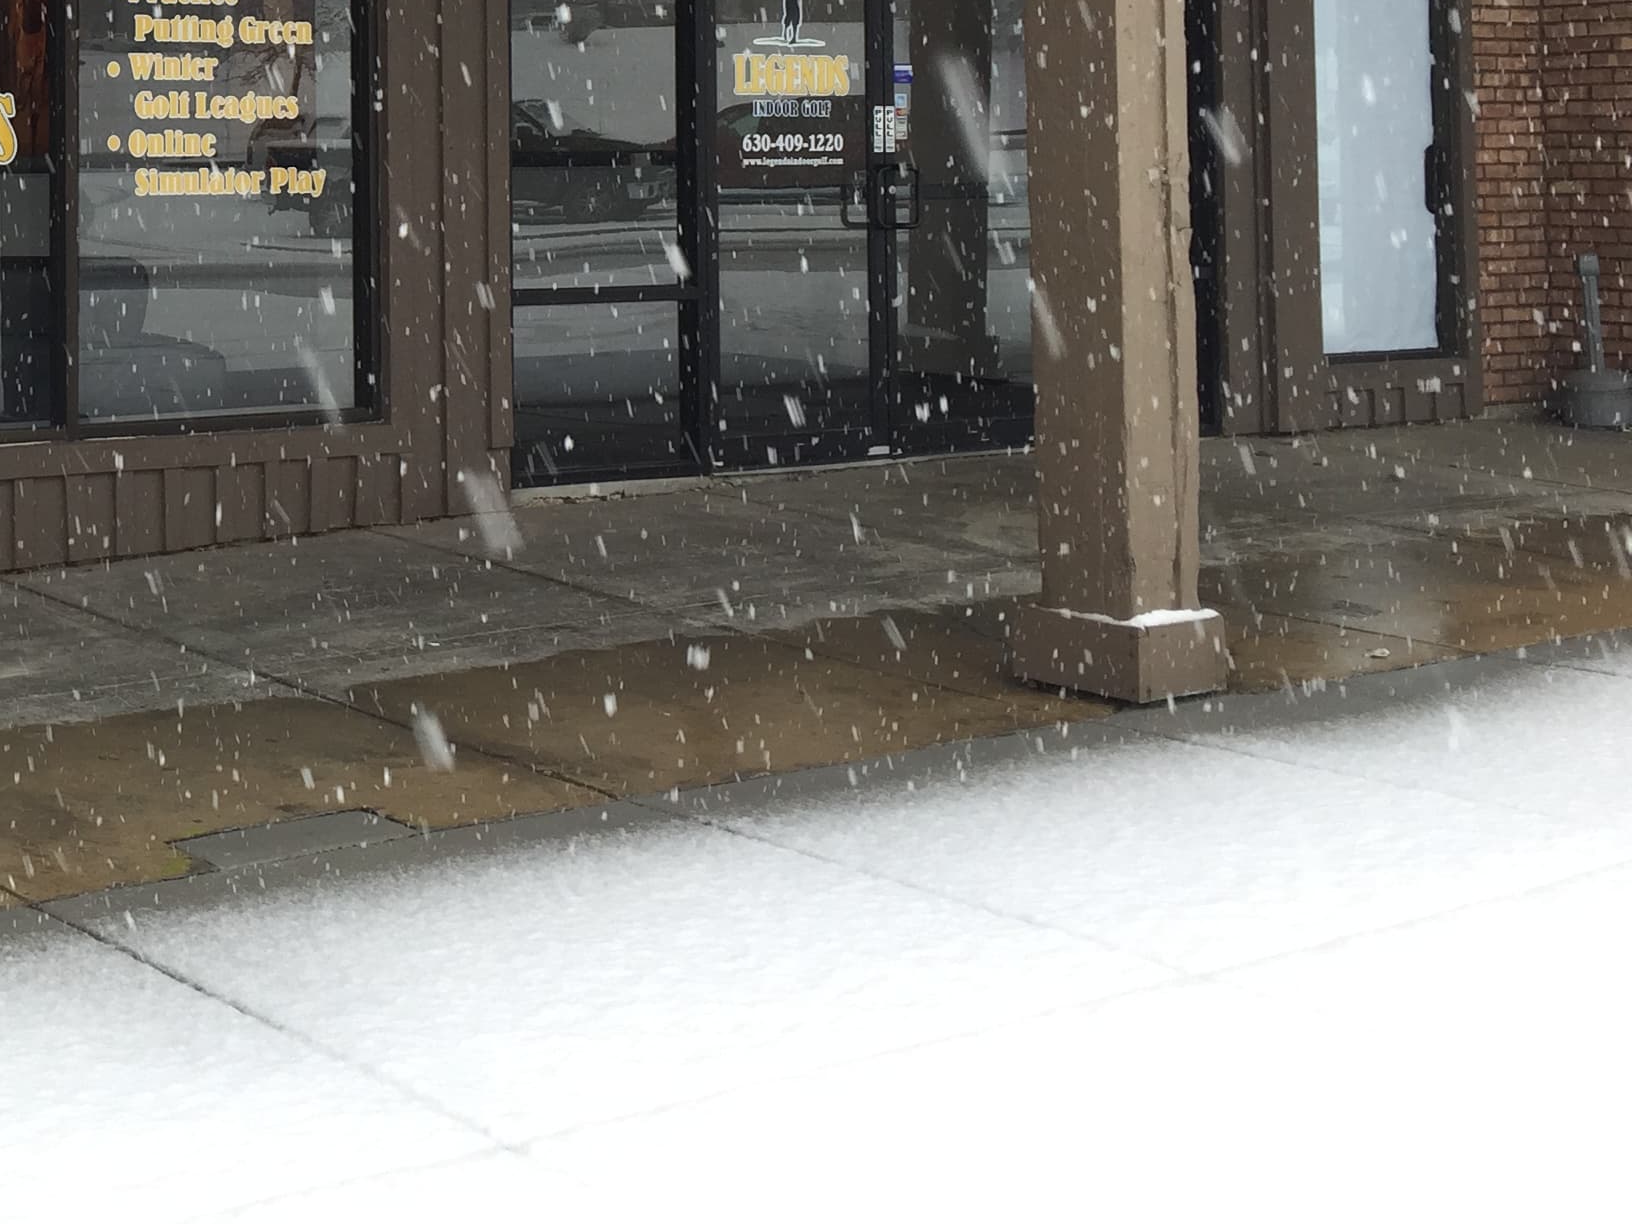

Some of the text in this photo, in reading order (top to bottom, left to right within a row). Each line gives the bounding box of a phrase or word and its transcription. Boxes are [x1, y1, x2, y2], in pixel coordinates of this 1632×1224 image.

[134, 14, 313, 48] Putting Green
[128, 53, 218, 81] Winter
[733, 53, 850, 96] LEGENDS
[134, 91, 299, 124] Golf Leagues
[753, 99, 832, 117] INDOOR GOLF
[874, 109, 882, 137] PULL
[886, 109, 894, 137] PULL
[128, 129, 216, 157] Online
[742, 133, 844, 152] 630-409-1220
[135, 167, 326, 198] Simulator Play
